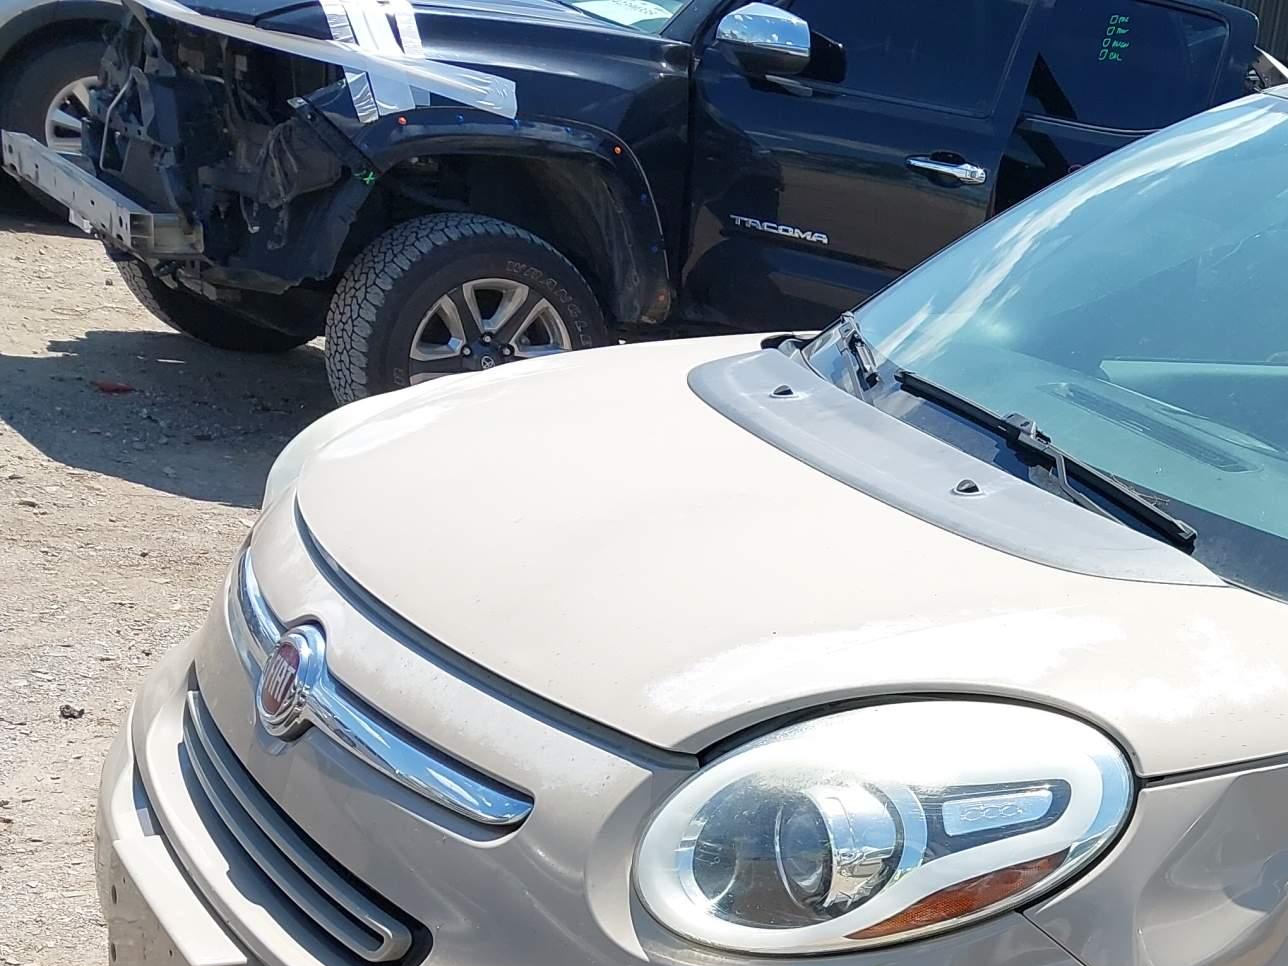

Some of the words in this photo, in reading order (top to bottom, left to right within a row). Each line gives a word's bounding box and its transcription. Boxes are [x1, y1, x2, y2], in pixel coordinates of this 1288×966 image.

[729, 214, 828, 244] TACOMA
[506, 260, 593, 346] WRANGLE
[264, 653, 296, 703] FIAT
